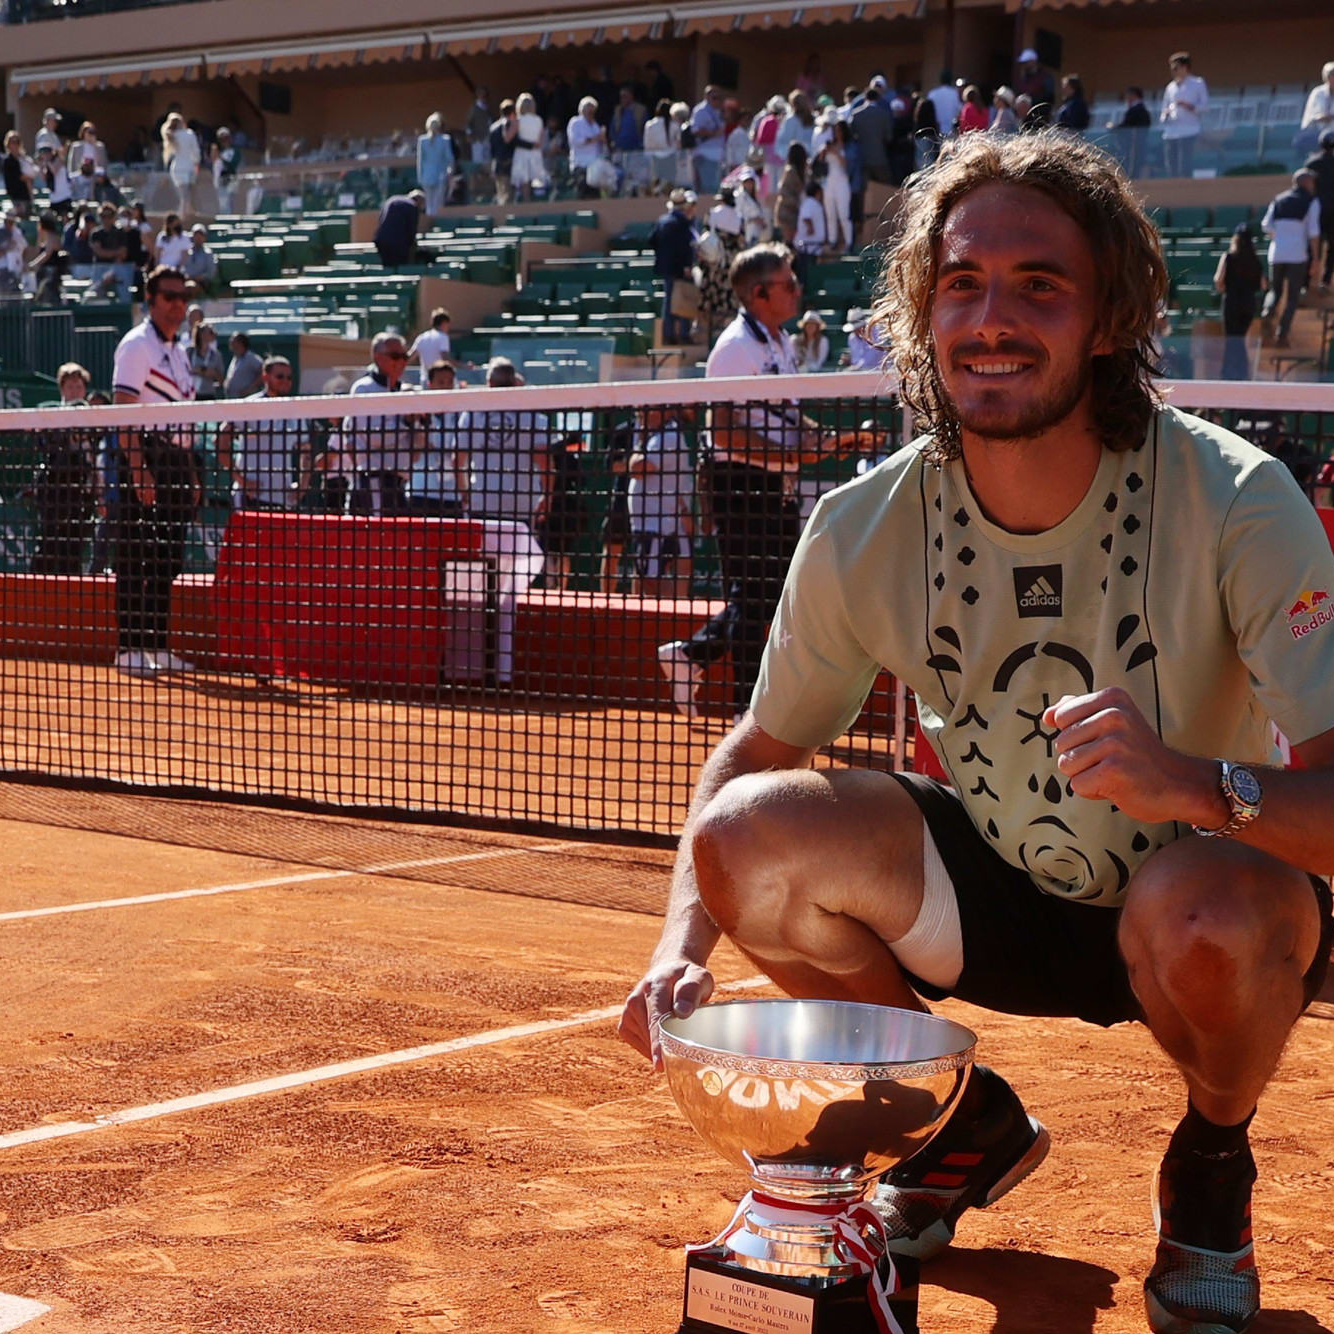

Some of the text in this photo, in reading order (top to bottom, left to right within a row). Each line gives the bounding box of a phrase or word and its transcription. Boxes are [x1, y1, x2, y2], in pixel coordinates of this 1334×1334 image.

[1019, 594, 1061, 607] adidas
[1290, 614, 1320, 640] Red
[731, 1282, 769, 1300] COUPE DE
[714, 1291, 725, 1301] LE
[728, 1294, 759, 1311] PRINCE
[761, 1303, 810, 1324] SOUVERAIN
